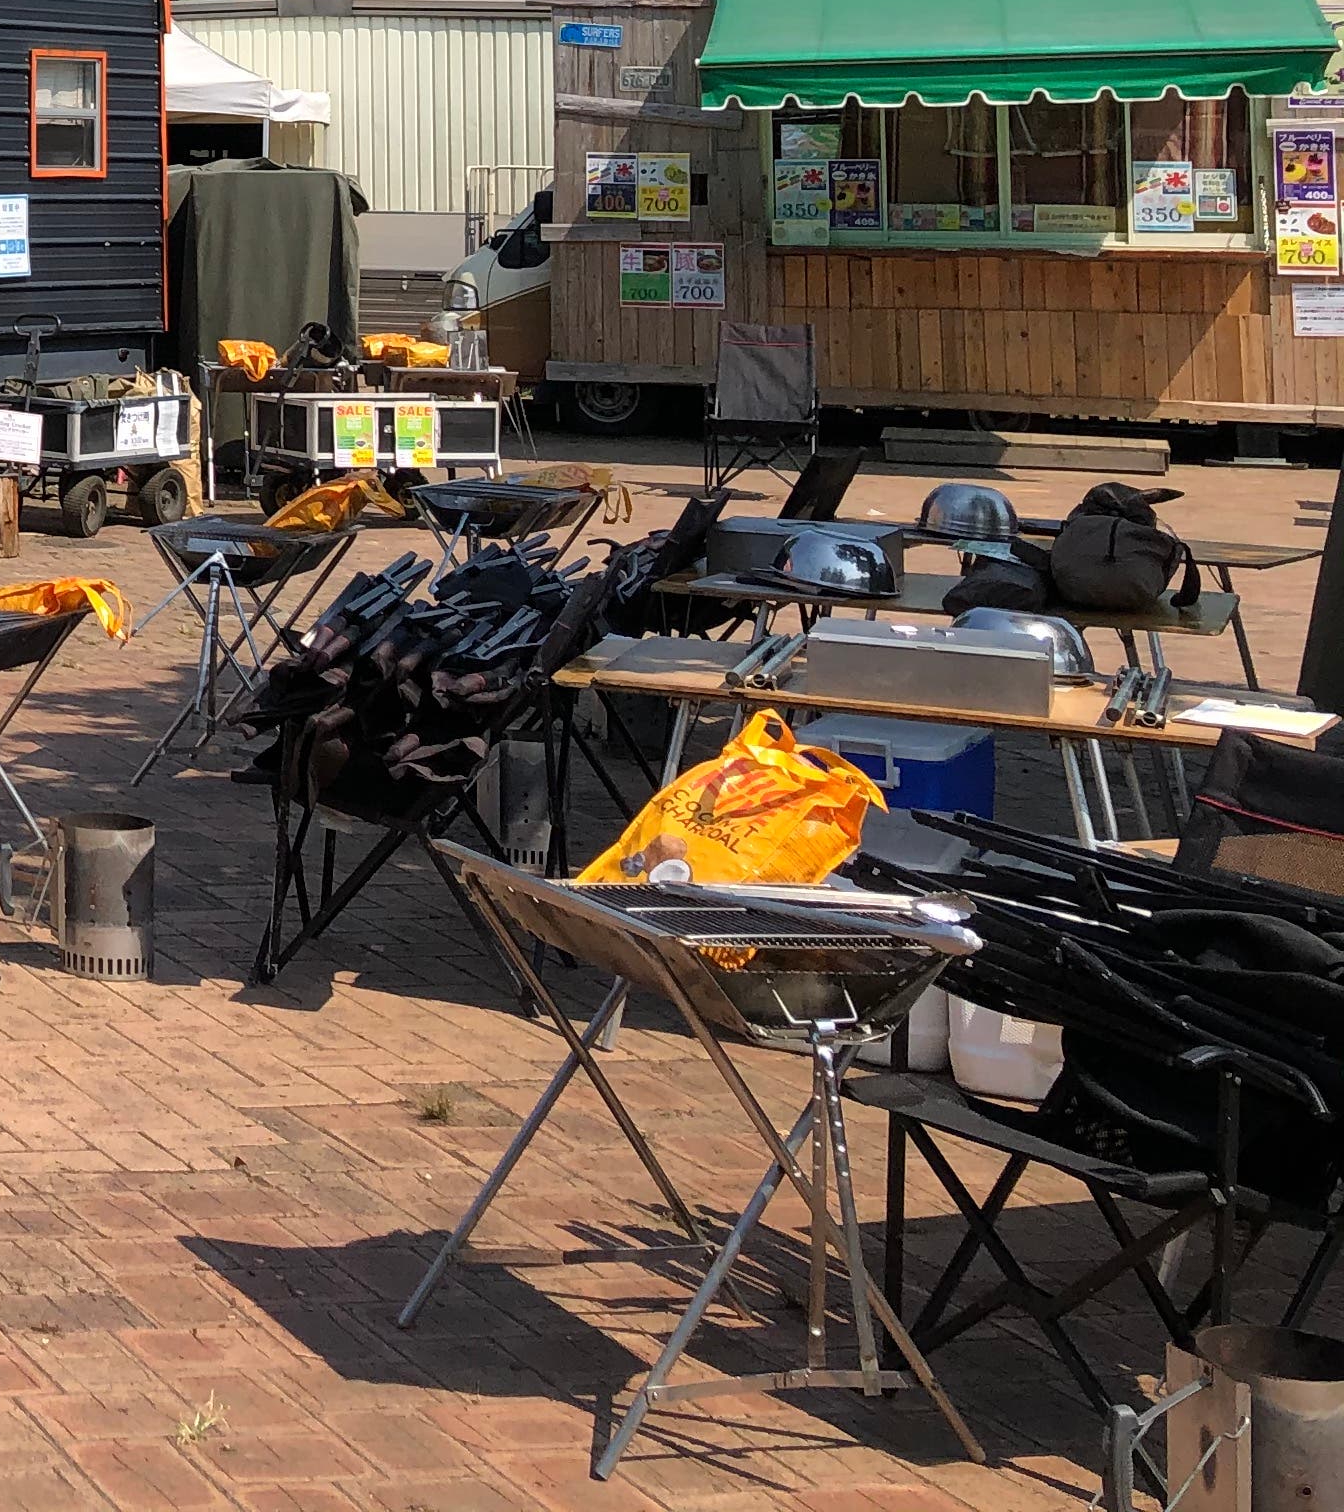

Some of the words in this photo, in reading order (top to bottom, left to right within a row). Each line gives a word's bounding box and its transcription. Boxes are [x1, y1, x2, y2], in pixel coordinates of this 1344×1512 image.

[581, 26, 621, 39] SURFERS
[1279, 134, 1331, 142] ブルーベリー
[830, 163, 878, 171] ブルーベリー
[1141, 206, 1183, 223] 350
[1284, 249, 1326, 265] 700
[630, 288, 658, 300] 700
[679, 285, 715, 300] 700
[336, 405, 372, 416] SALE
[398, 406, 433, 417] SALE
